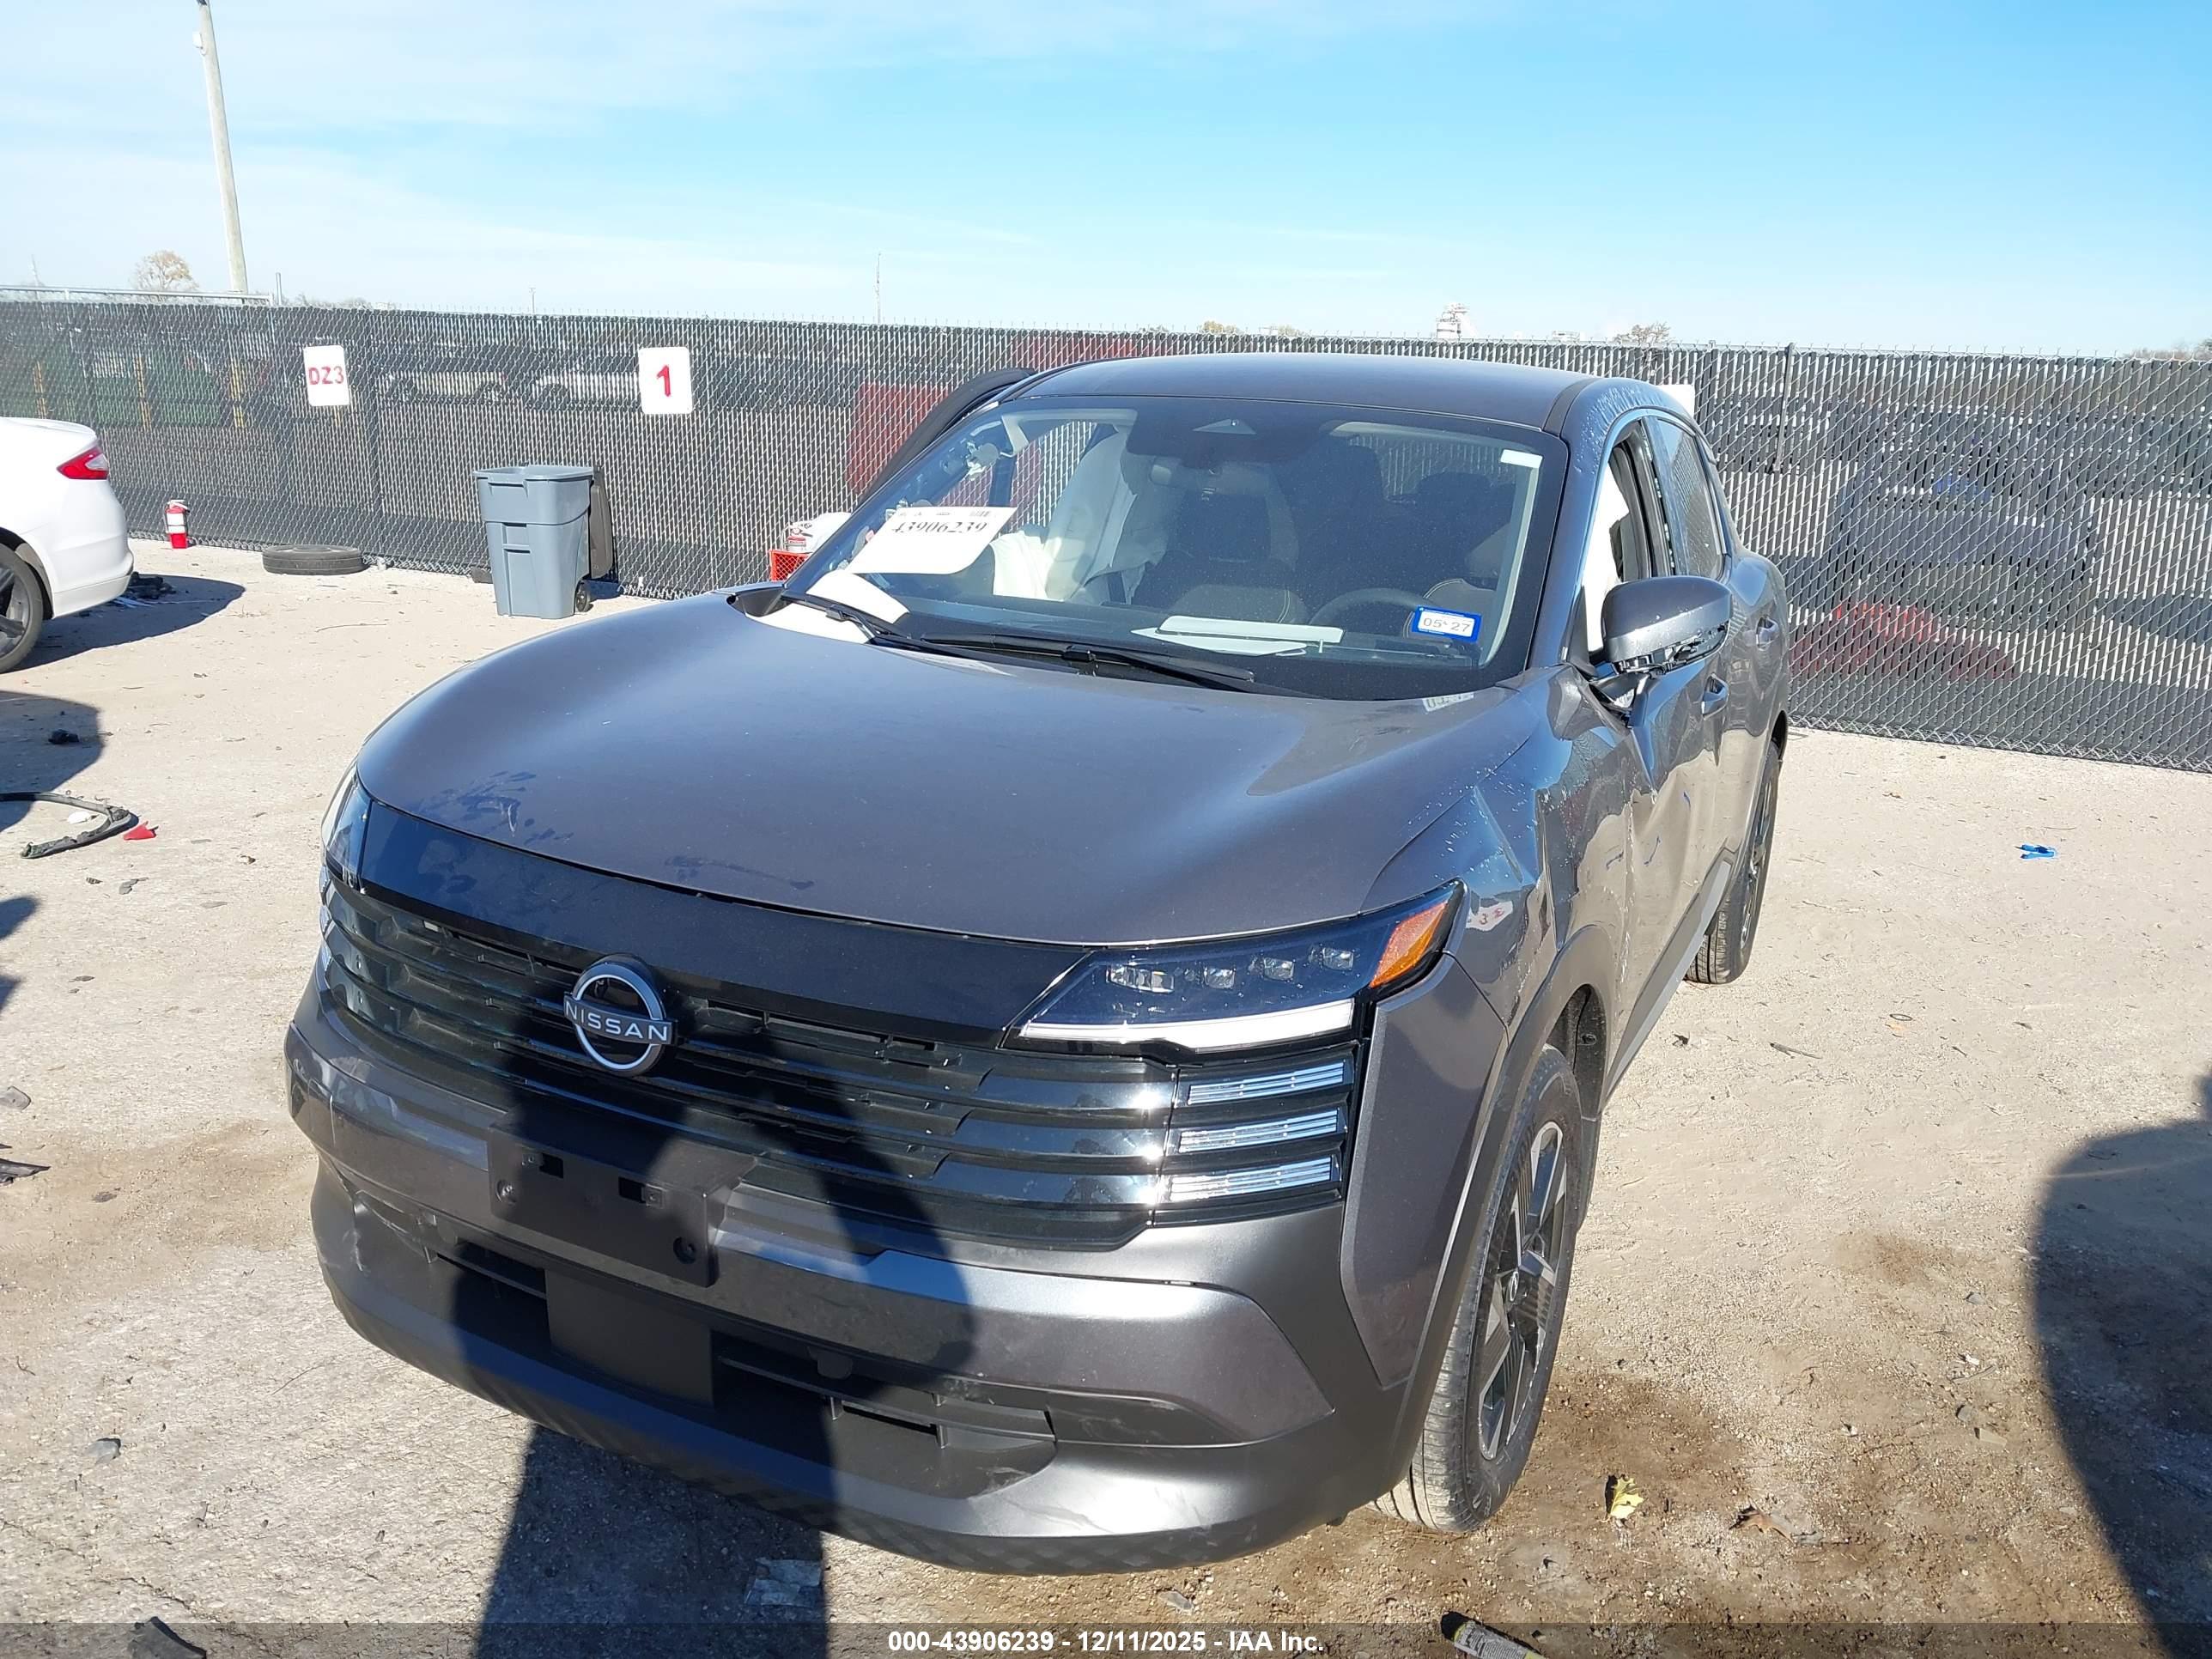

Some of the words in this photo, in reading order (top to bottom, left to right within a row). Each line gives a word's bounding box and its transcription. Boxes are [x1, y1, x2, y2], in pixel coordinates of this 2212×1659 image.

[308, 366, 344, 385] DZ3
[656, 364, 671, 397] 1
[891, 521, 988, 533] 43906239
[1423, 617, 1443, 629] 05
[1449, 621, 1471, 632] 27
[566, 1000, 668, 1042] NISSAN
